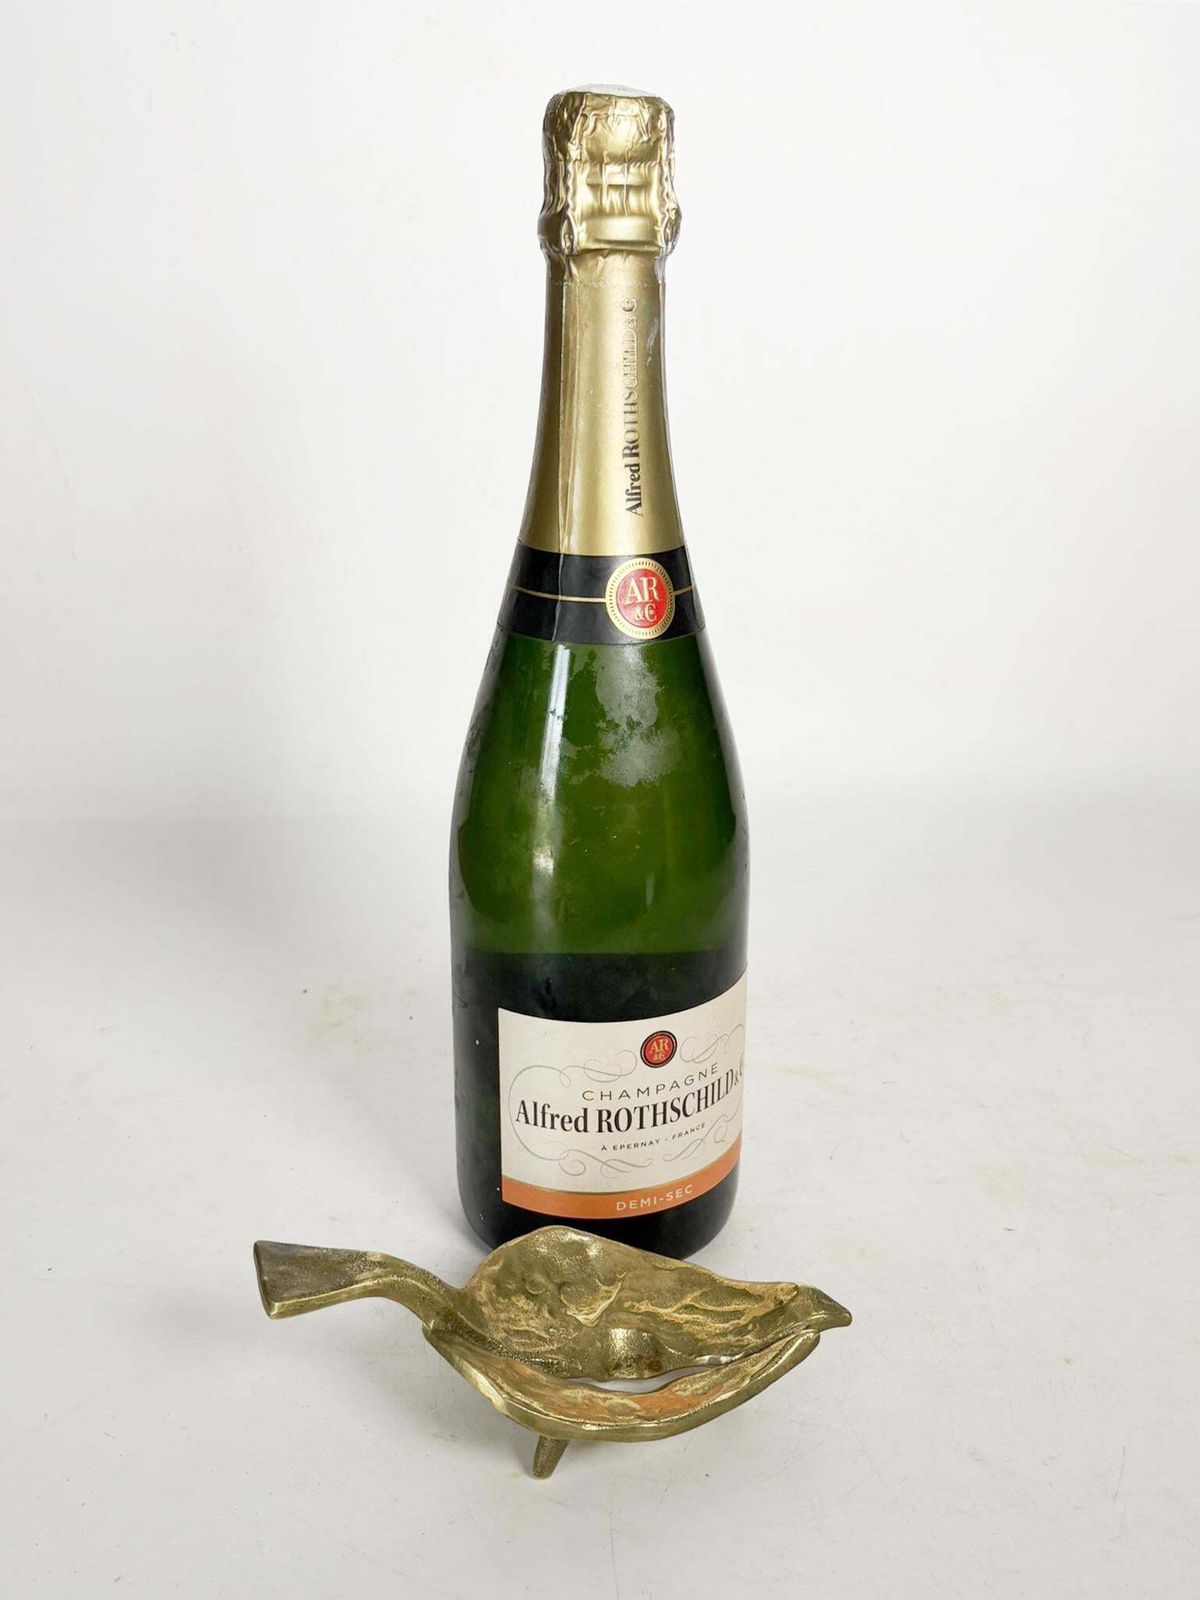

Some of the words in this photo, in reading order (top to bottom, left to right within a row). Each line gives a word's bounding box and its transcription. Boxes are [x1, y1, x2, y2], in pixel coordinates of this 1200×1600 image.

[622, 331, 640, 460] ROTHSCHILD
[624, 462, 643, 516] Alfred
[625, 576, 660, 605] AR
[650, 1038, 669, 1054] AR
[582, 1062, 718, 1101] CHAMPAGNE
[515, 1099, 588, 1133] Alfred
[612, 1138, 661, 1151] EPERNAY
[672, 1122, 706, 1140] FRANCE
[616, 1184, 694, 1211] DEMI-SEC
